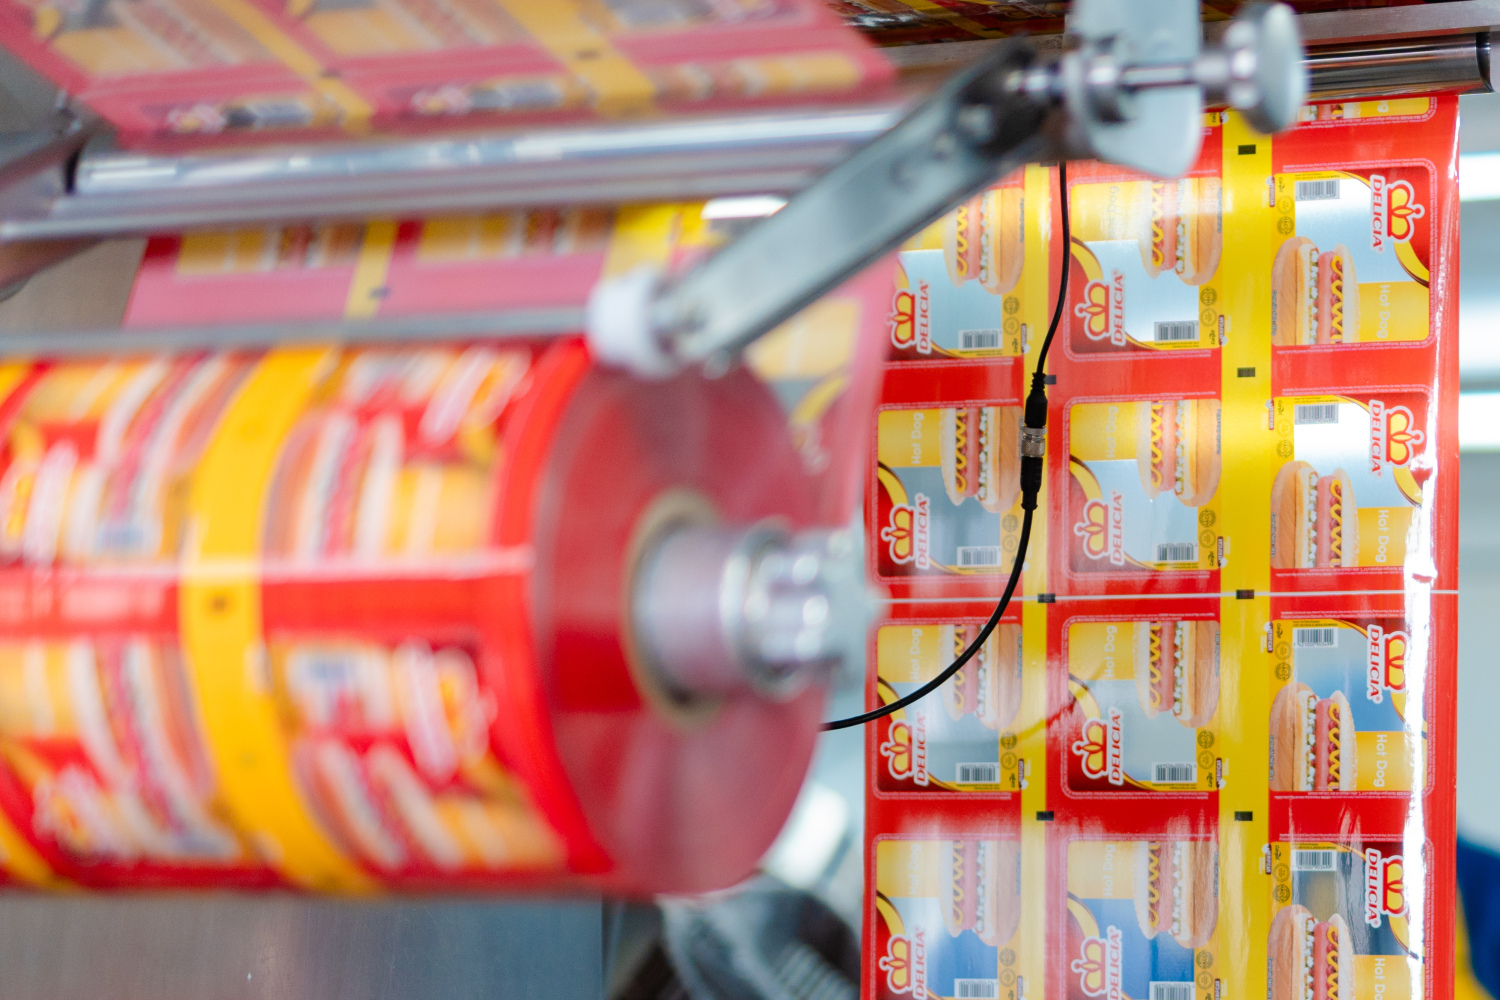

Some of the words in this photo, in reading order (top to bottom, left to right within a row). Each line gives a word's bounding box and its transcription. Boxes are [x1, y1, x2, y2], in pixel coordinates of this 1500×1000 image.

[1379, 285, 1390, 308] Hot
[1377, 311, 1390, 338] Dog
[912, 413, 924, 439] Dog
[1106, 406, 1119, 433] Dog
[912, 442, 921, 464] Hot
[1106, 435, 1116, 458] Hot
[1379, 510, 1389, 531] Hot
[1376, 536, 1389, 563] Dog
[910, 629, 923, 655] Dog
[1104, 625, 1117, 652] Dog
[910, 659, 920, 680] Hot
[1104, 656, 1114, 677] Hot
[1377, 734, 1387, 755] Hot
[1373, 760, 1387, 787] Dog
[1104, 845, 1115, 871] Dog
[1104, 874, 1113, 896] Hot
[1375, 958, 1385, 980] Hot
